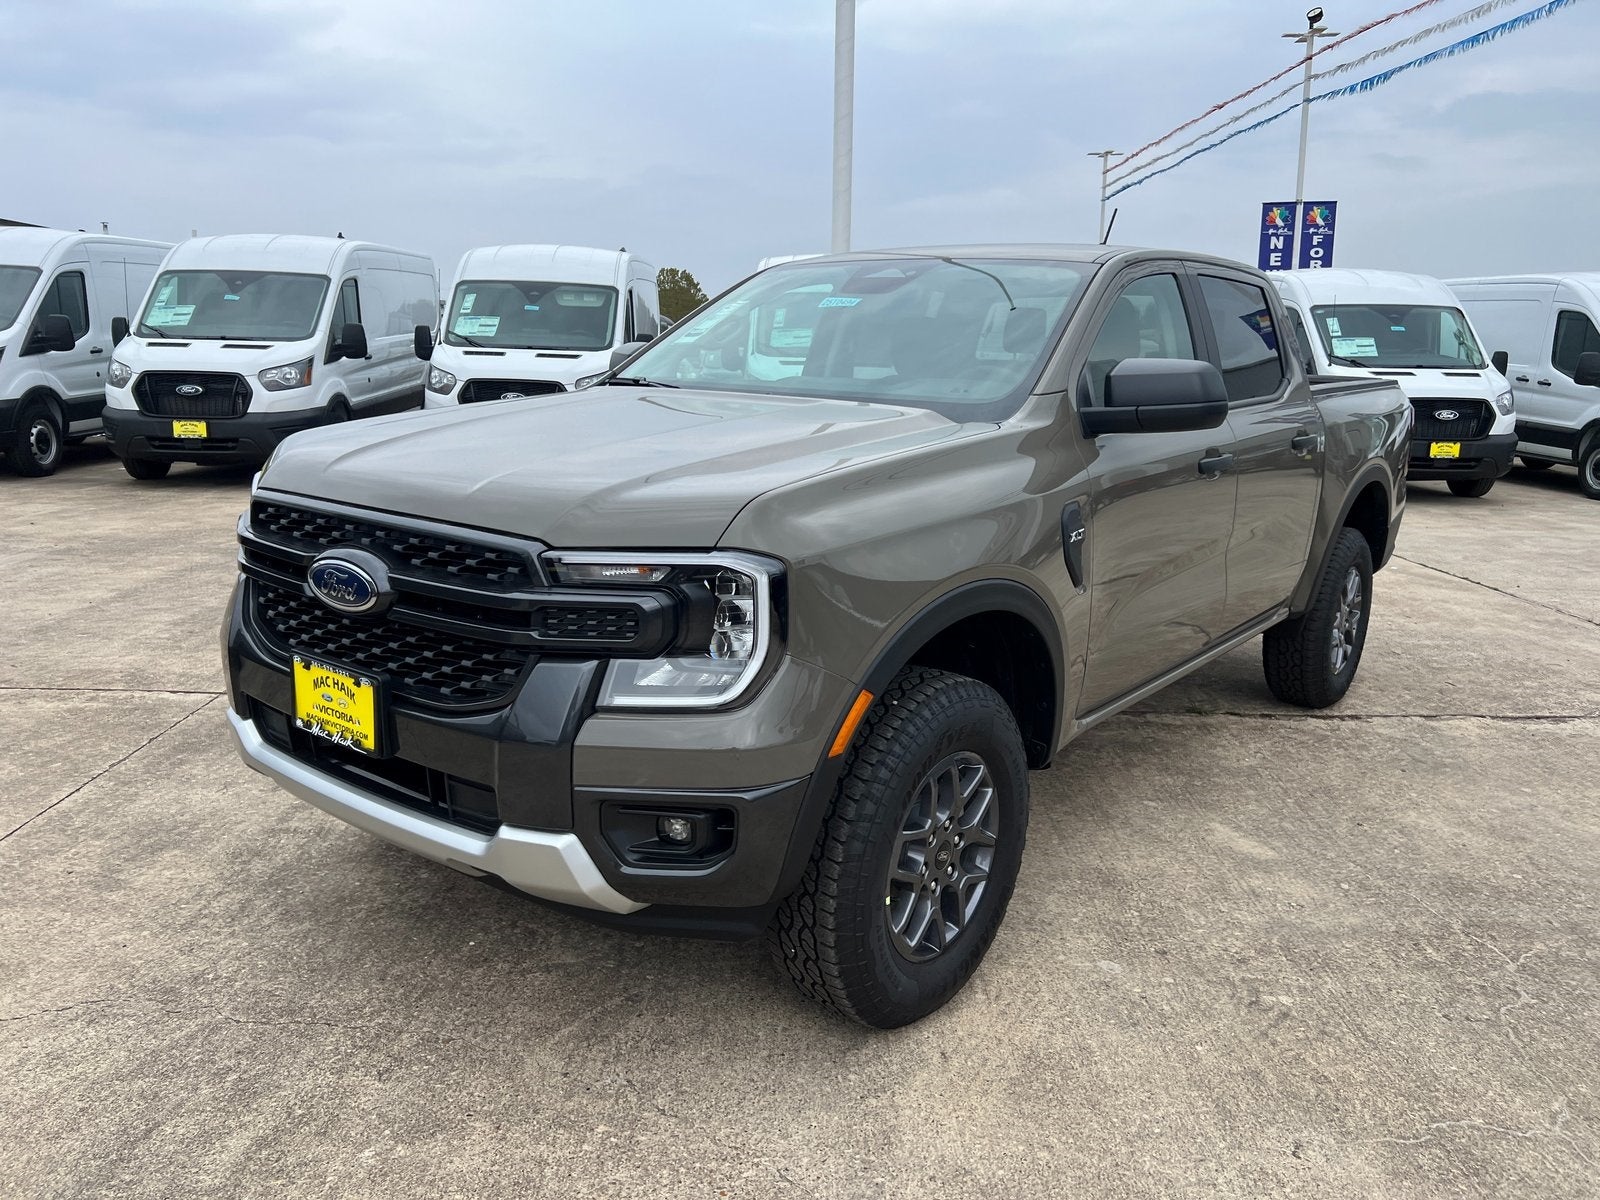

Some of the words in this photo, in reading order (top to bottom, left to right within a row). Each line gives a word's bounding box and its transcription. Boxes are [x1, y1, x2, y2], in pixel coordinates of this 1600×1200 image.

[321, 569, 358, 601] Ford
[313, 675, 331, 691] MAC
[332, 677, 357, 705] HAIK
[318, 703, 354, 725] VICTORIA
[307, 722, 331, 739] Mac
[331, 731, 360, 750] Haik
